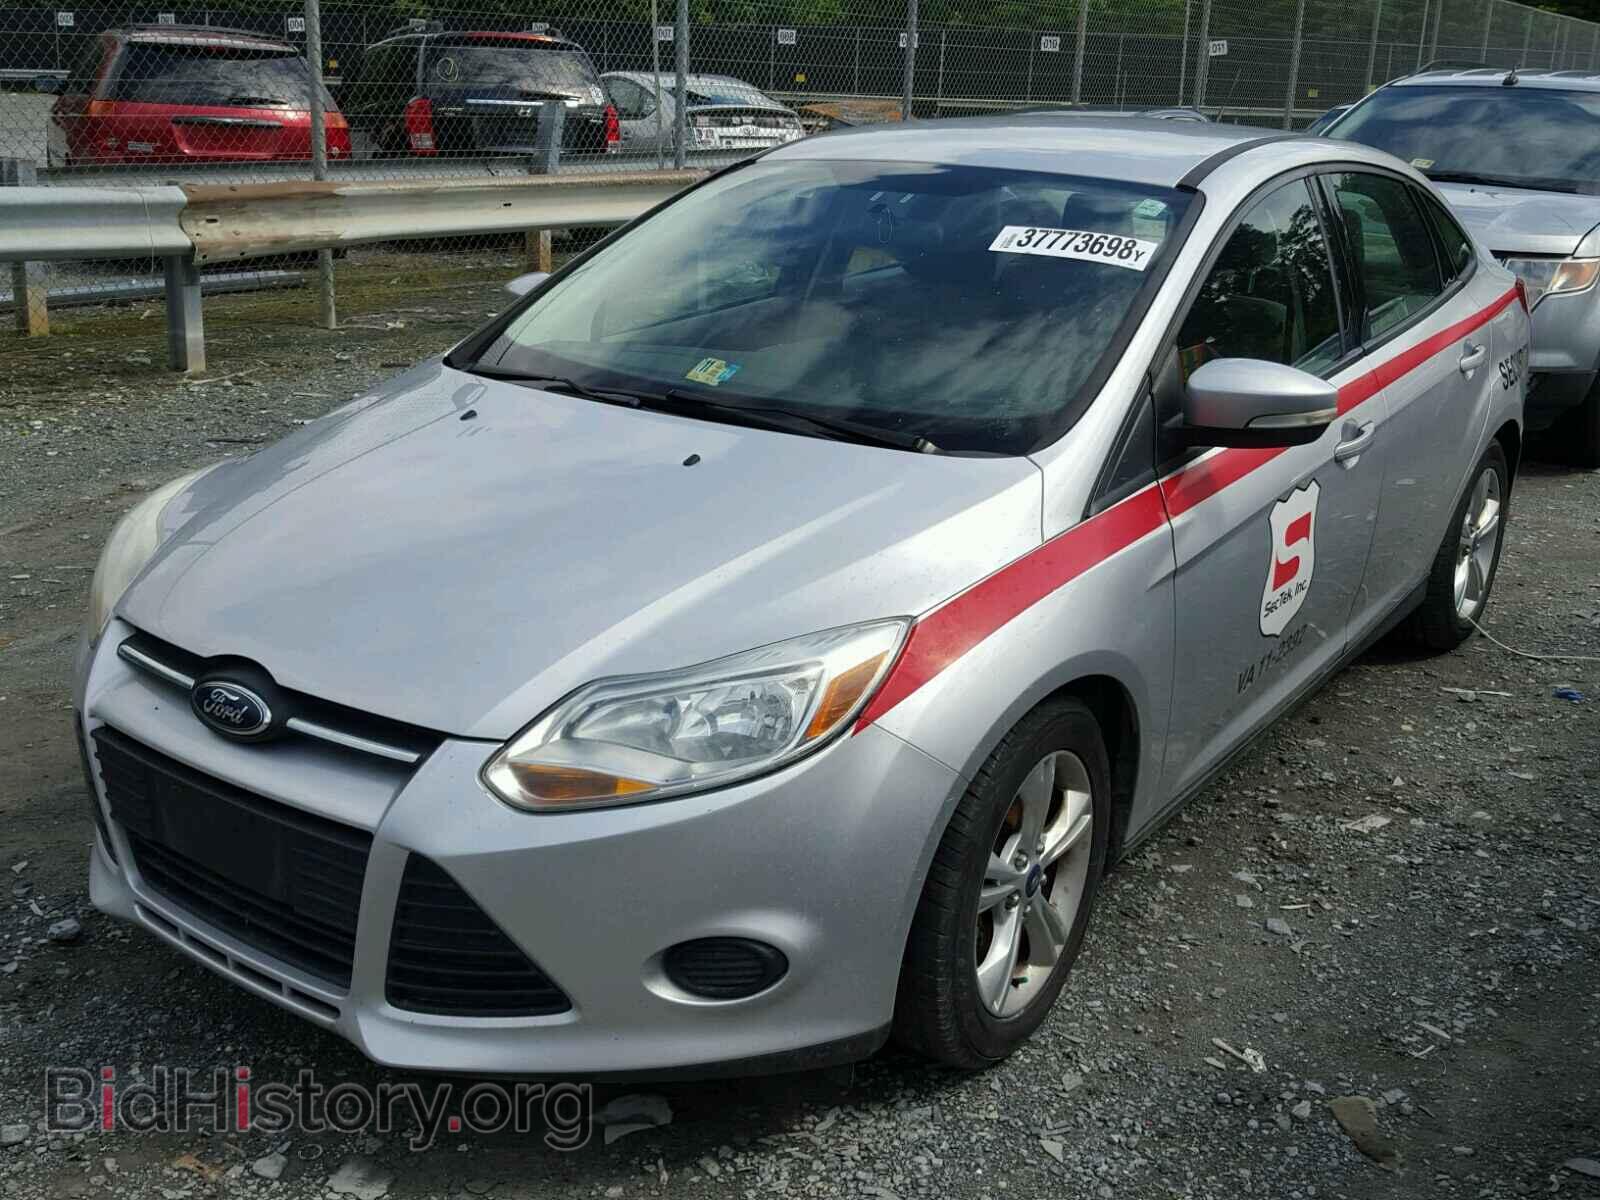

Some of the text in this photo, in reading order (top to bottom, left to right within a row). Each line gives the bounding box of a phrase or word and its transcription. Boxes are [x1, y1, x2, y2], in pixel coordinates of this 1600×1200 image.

[290, 19, 304, 30] 004
[1237, 663, 1255, 694] VA
[203, 688, 249, 724] Ford
